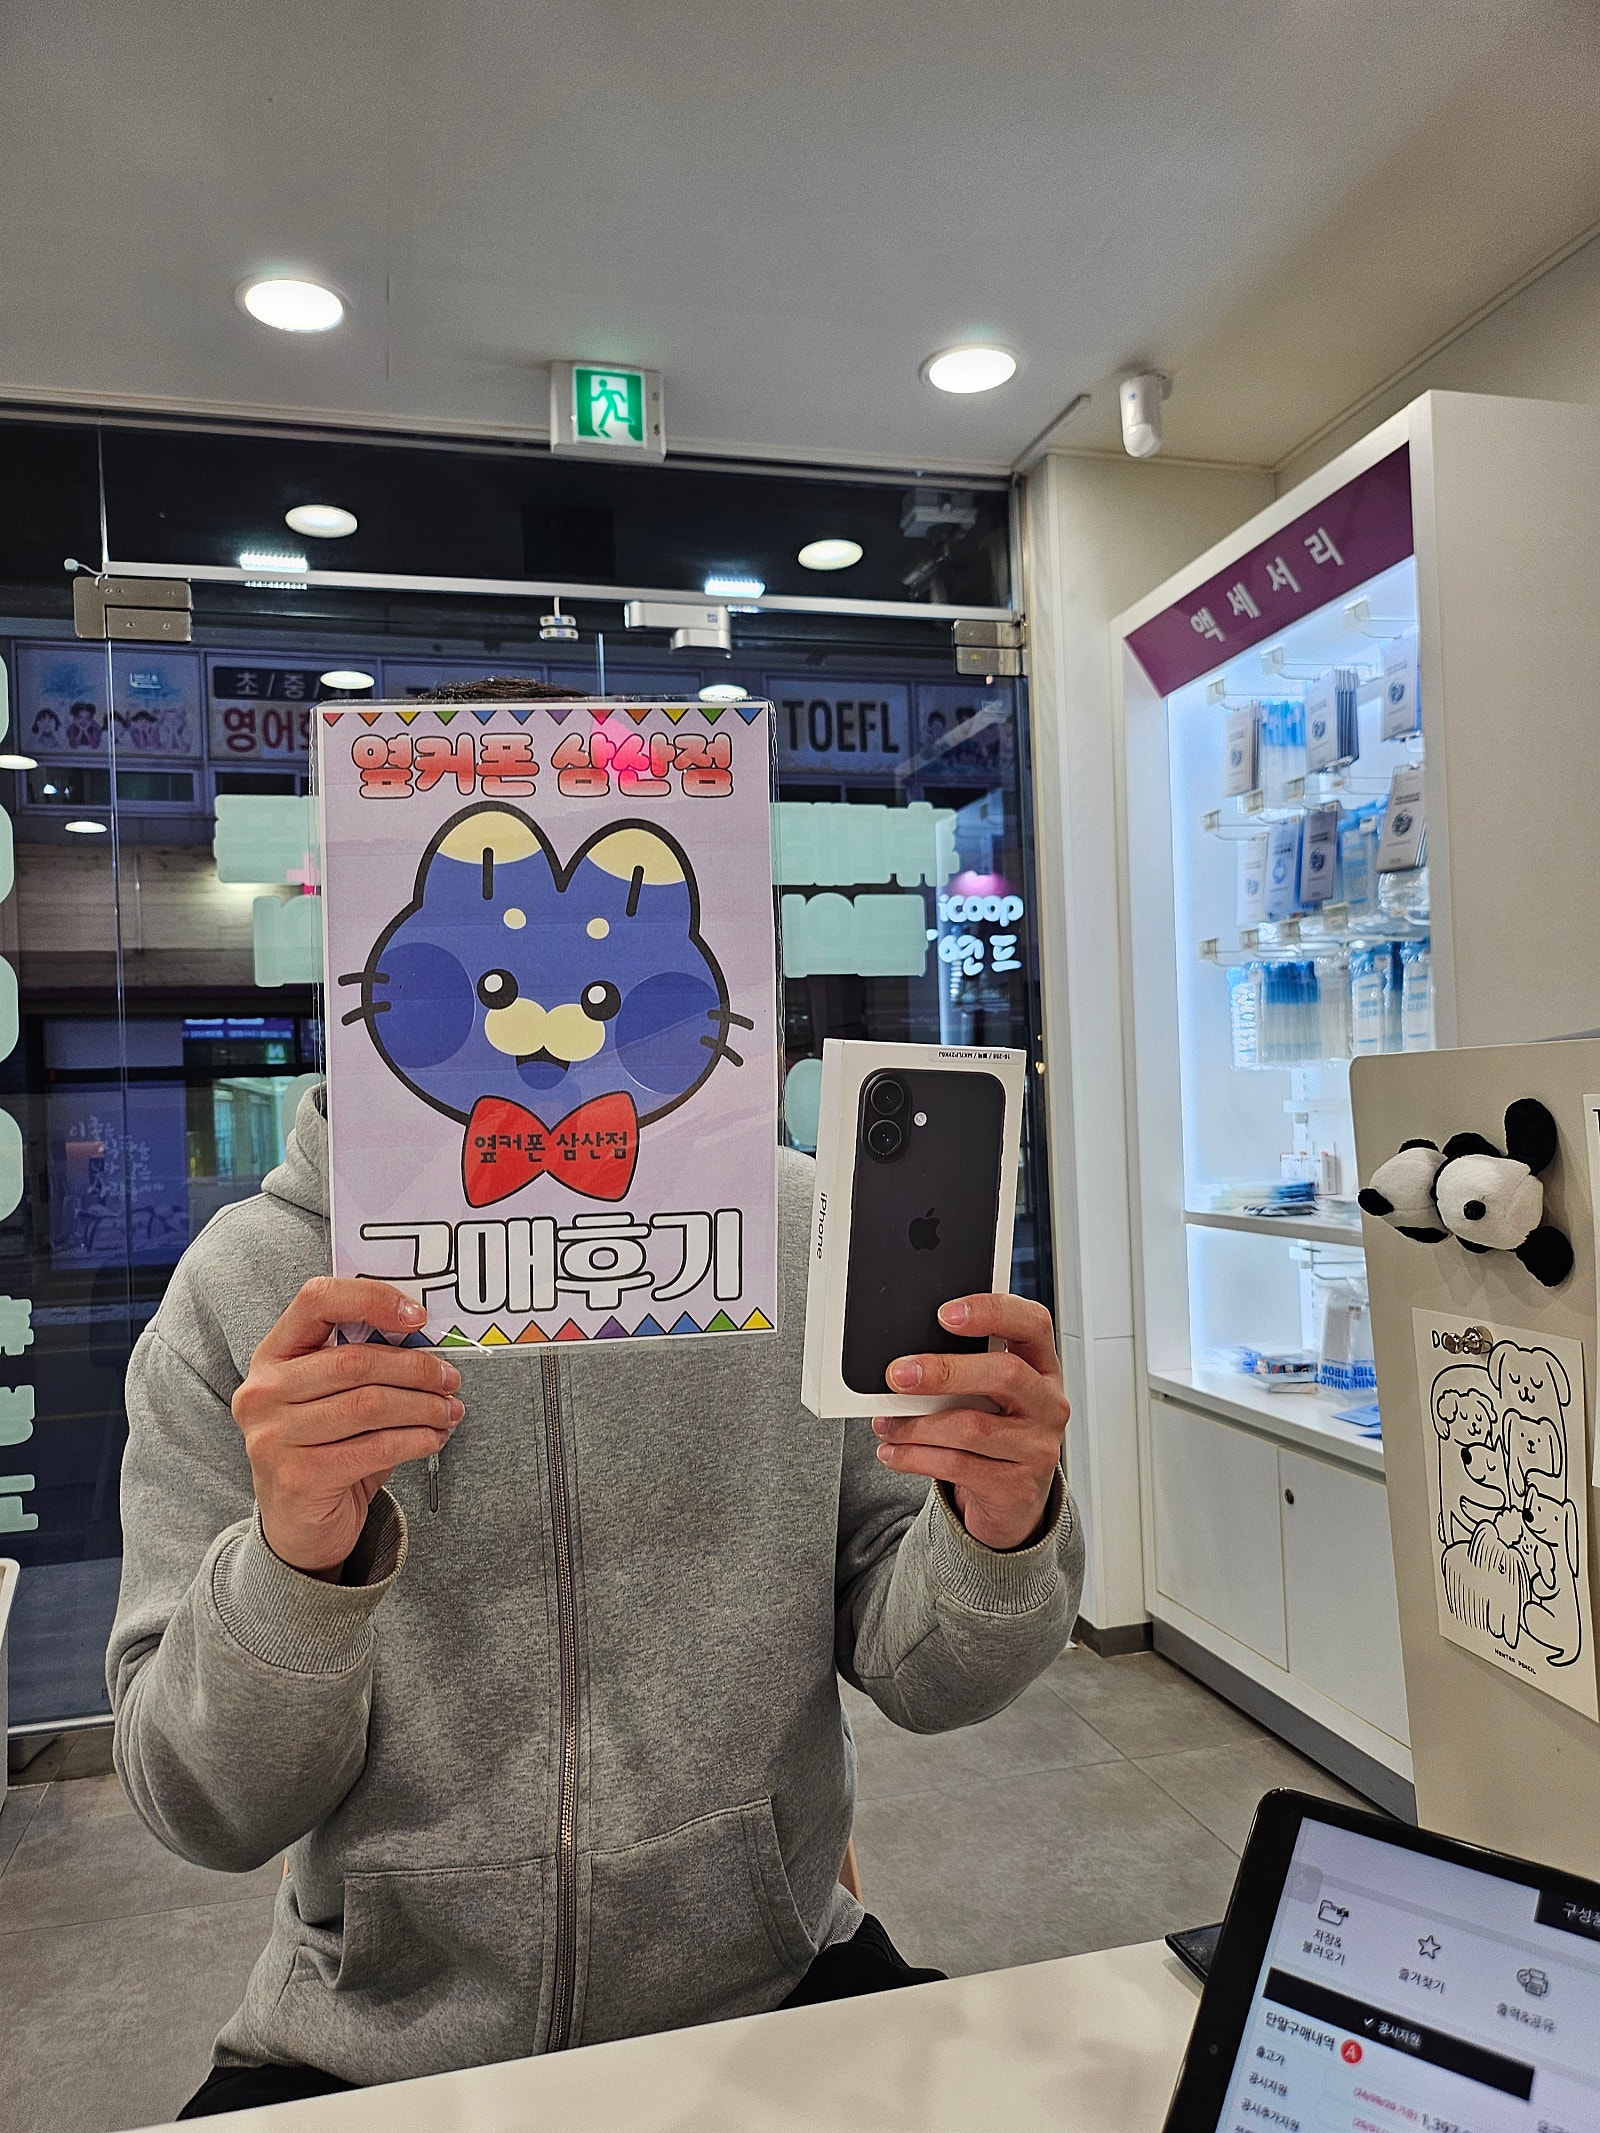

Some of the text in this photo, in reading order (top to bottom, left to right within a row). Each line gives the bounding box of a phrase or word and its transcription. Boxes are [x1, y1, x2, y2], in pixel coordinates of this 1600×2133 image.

[1190, 527, 1345, 643] 액세서리
[224, 707, 309, 753] 영어
[782, 697, 900, 754] TOEFL
[351, 731, 735, 800] 옆커폰 삼산점
[937, 894, 1025, 928] icoop
[474, 1130, 629, 1164] 옆커폰 삼산점
[815, 1191, 828, 1260] iPhone
[356, 1207, 743, 1314] 구매후기
[1265, 2011, 1335, 2052] 단말구매내역
